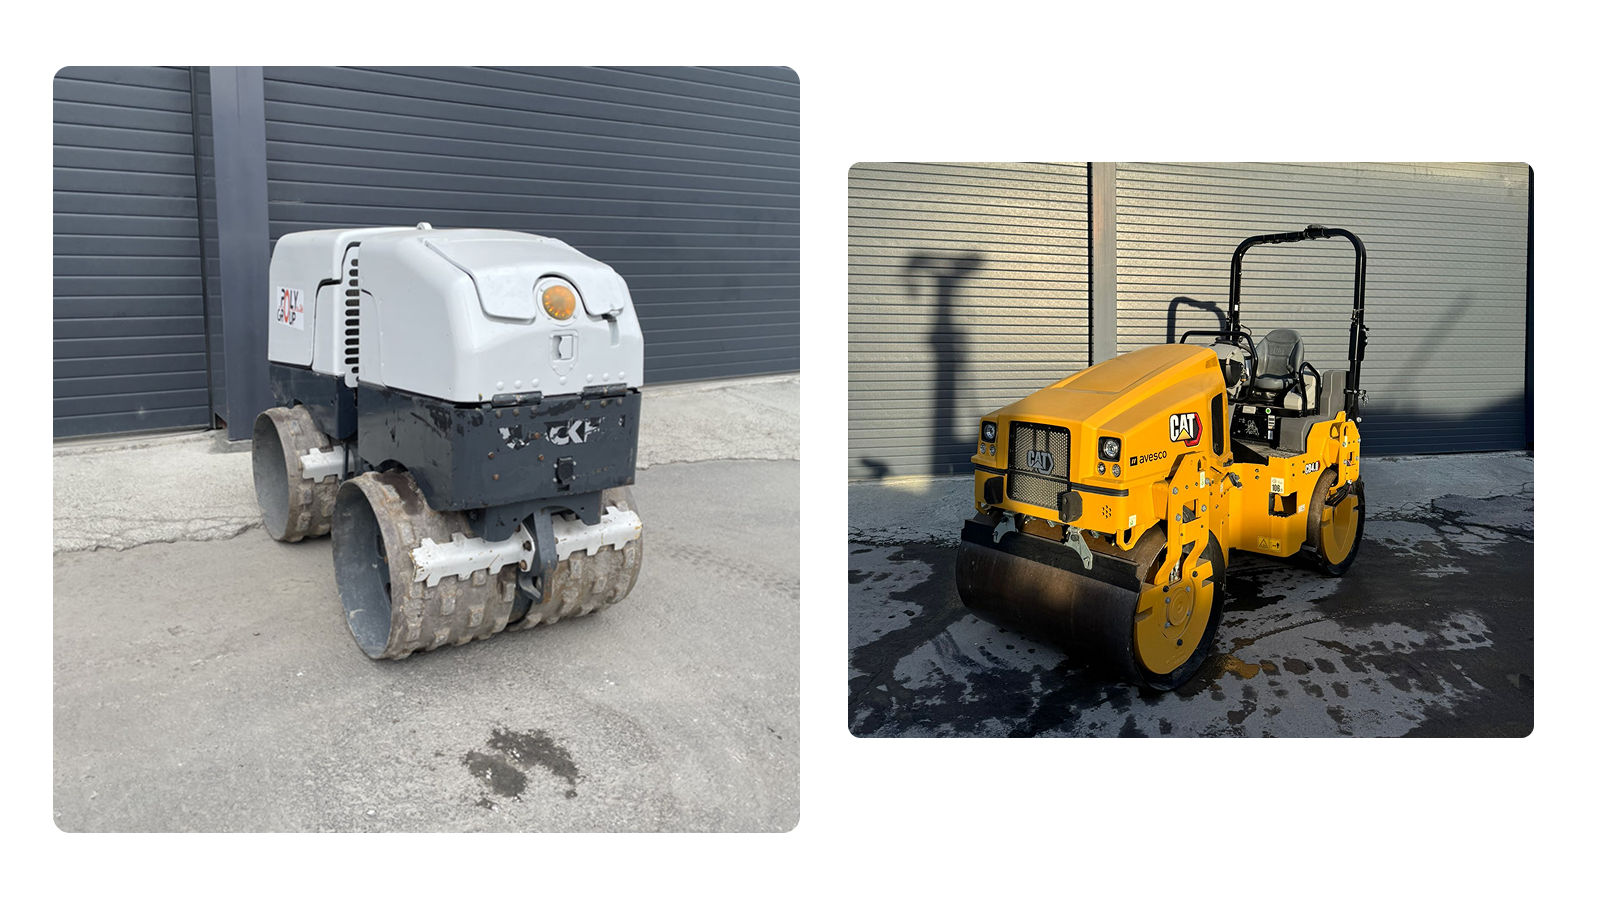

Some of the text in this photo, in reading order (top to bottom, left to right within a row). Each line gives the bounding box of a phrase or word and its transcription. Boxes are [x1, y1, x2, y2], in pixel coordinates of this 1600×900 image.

[280, 288, 299, 312] POLY
[1169, 413, 1196, 442] CAT
[1027, 450, 1049, 470] CAT
[1139, 451, 1167, 464] avesco
